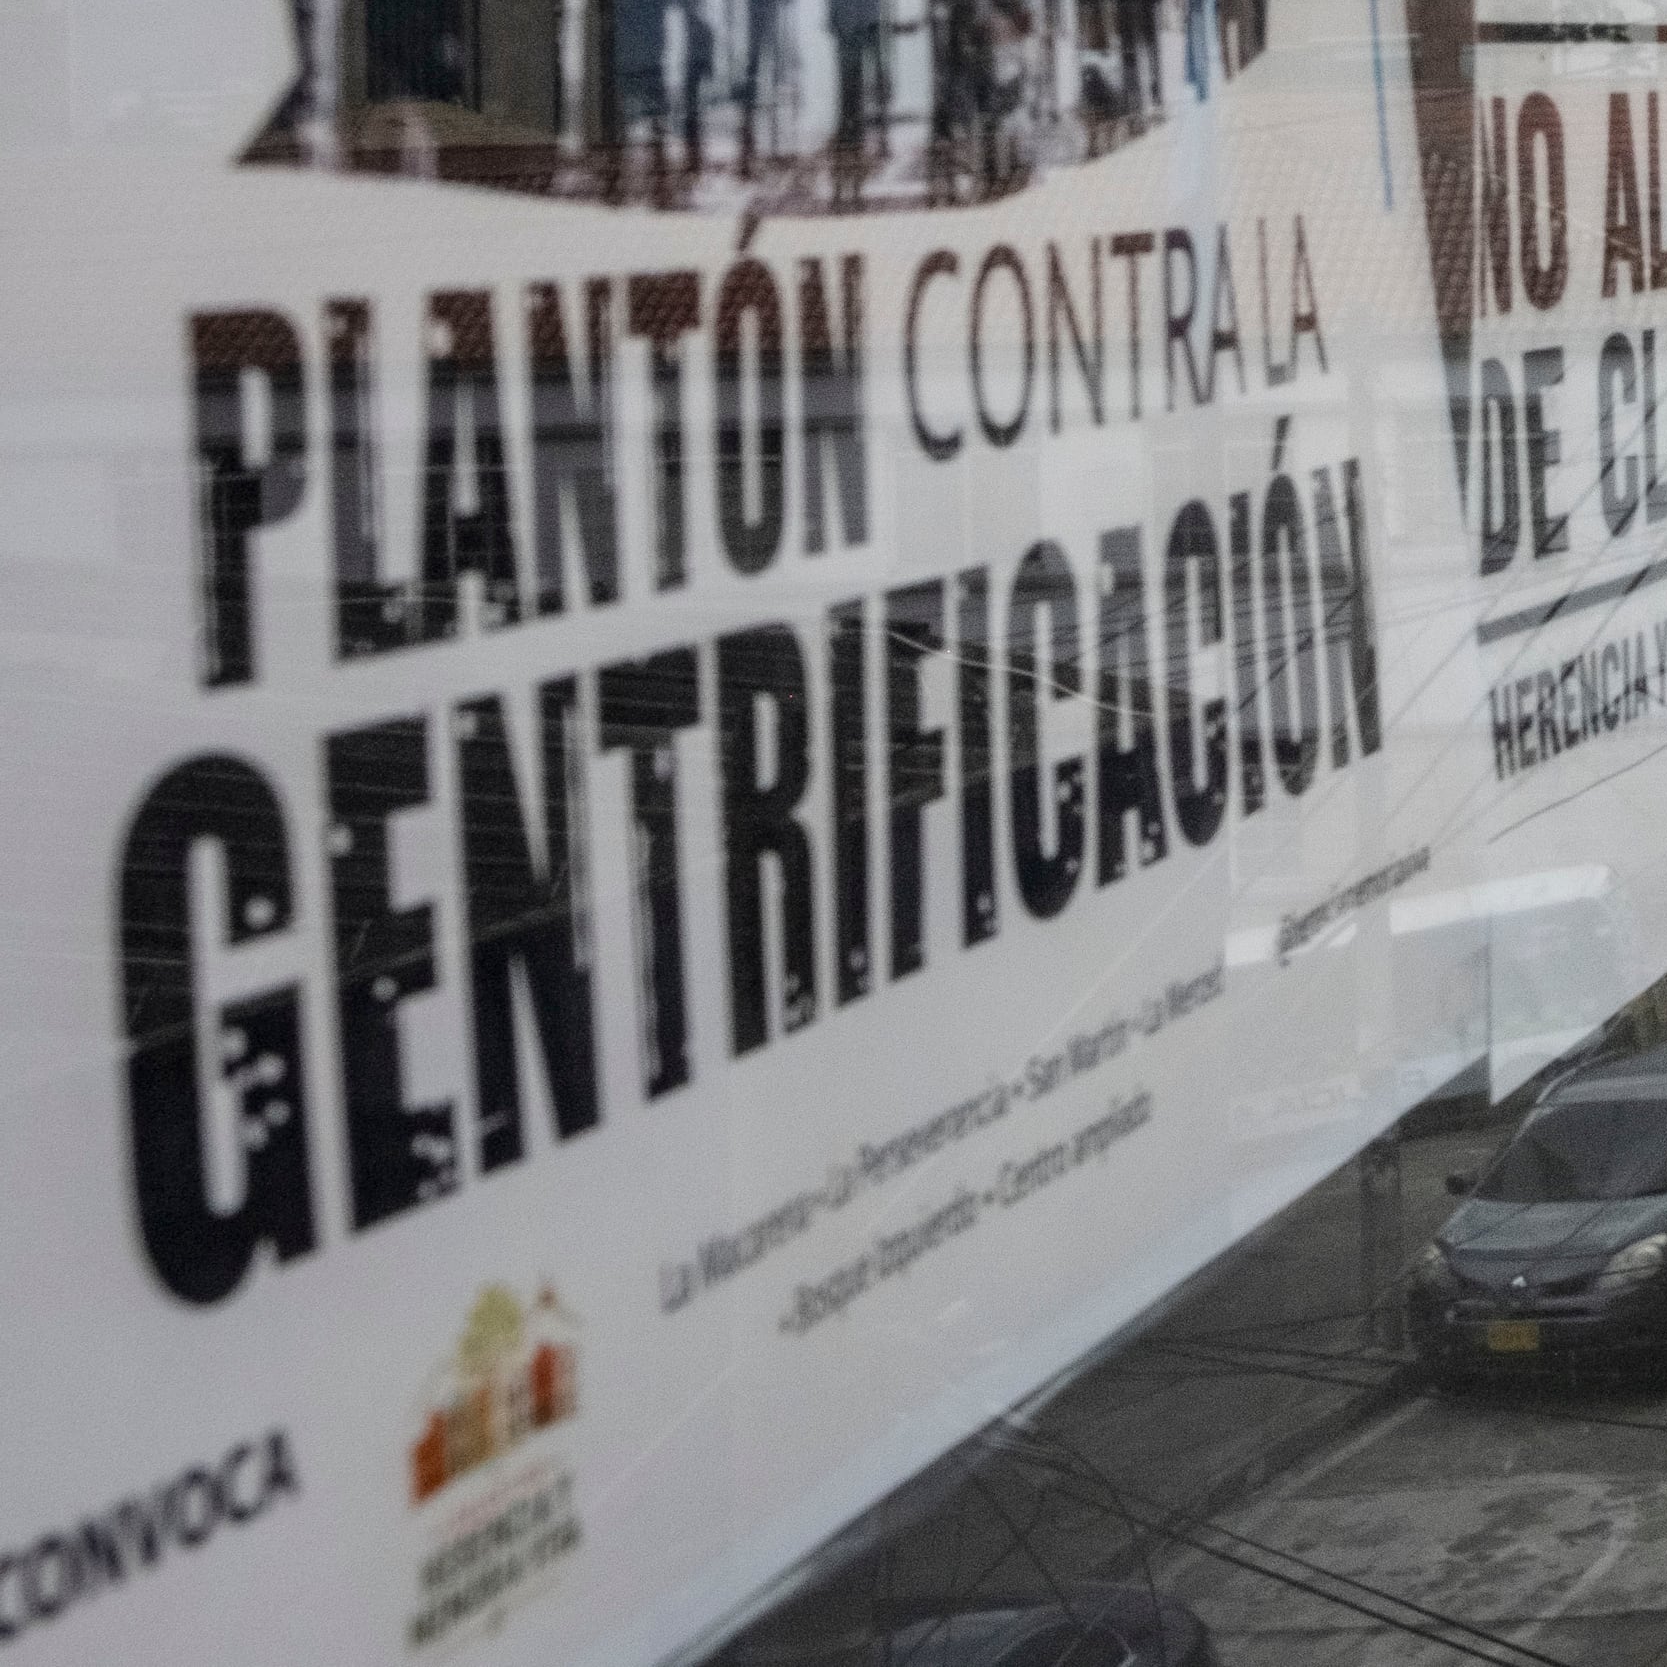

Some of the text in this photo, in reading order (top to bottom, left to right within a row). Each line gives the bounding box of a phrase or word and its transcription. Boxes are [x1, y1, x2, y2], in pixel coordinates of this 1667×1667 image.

[1478, 91, 1568, 318] NO
[188, 208, 1328, 691] PLANTÓN CONTRA LA
[1479, 346, 1569, 577] DE
[1489, 629, 1650, 782] HERENCIA
[112, 417, 1383, 1309] GENTRIFICACIÓN
